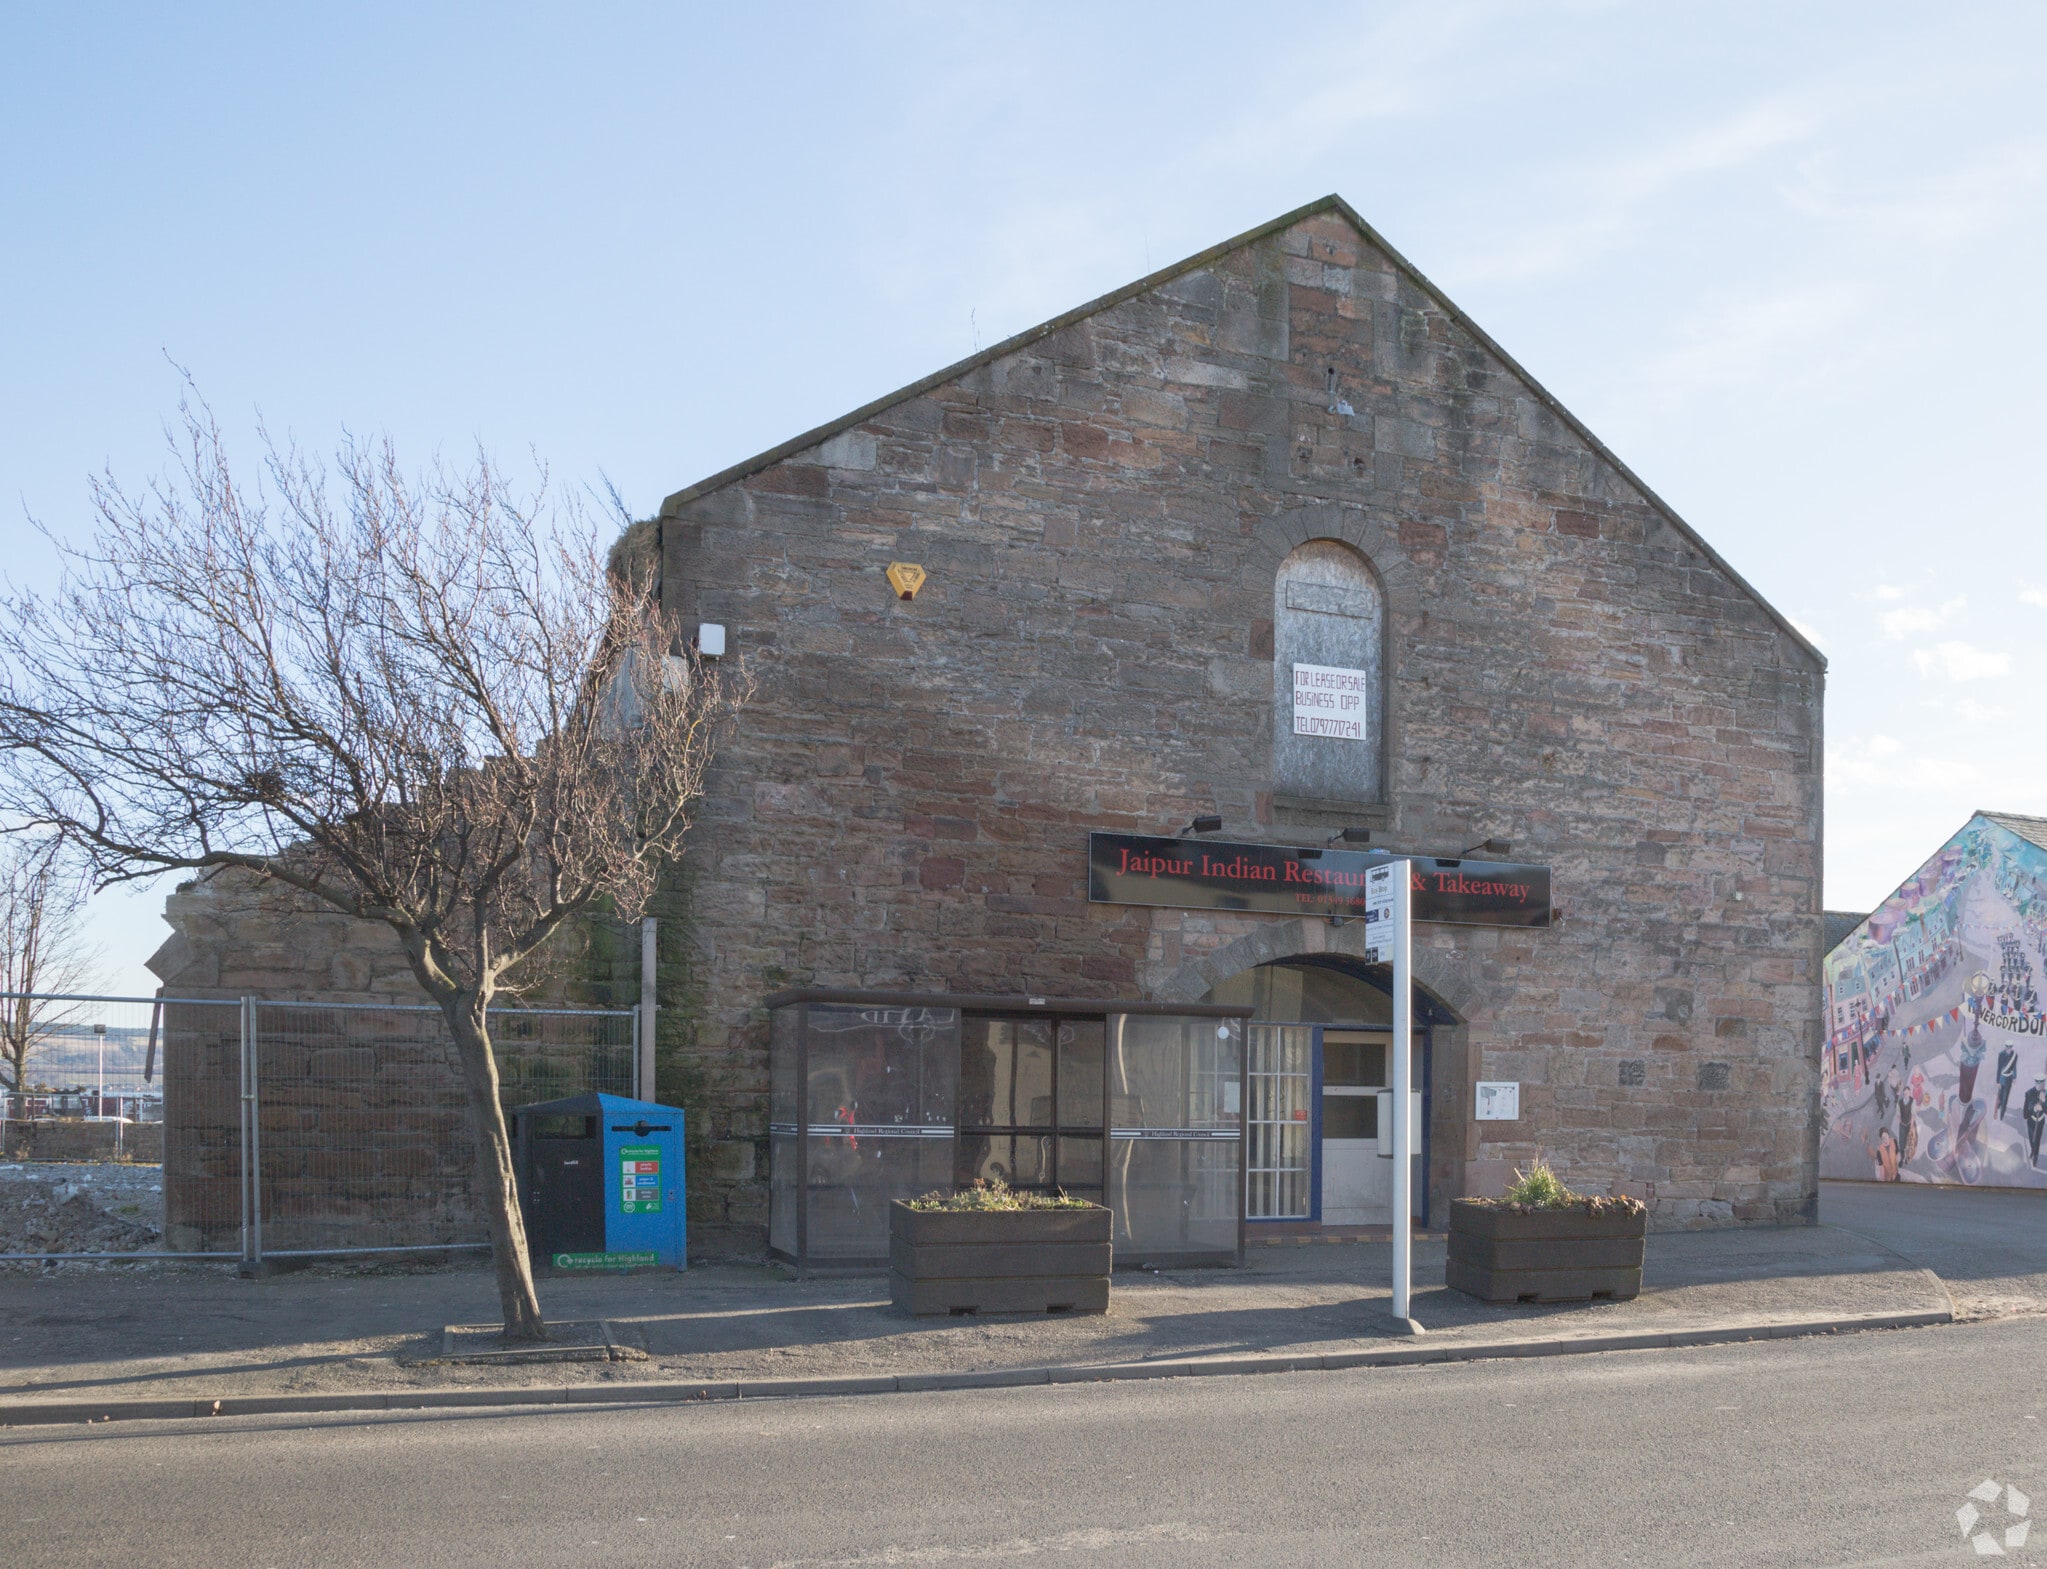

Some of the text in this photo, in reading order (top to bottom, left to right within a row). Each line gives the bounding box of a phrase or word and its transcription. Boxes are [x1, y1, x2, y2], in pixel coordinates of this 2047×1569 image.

[1296, 671, 1365, 692] FOR LEASE OR SALE
[1341, 695, 1359, 710] OPP
[1296, 716, 1309, 733] TEL
[1115, 848, 1530, 903] Jaipur Indian Restaur & Takeaway
[1968, 1003, 2047, 1037] IVERGORDO
[854, 1127, 877, 1135] Highland
[574, 1253, 655, 1265] recycle for Highland
